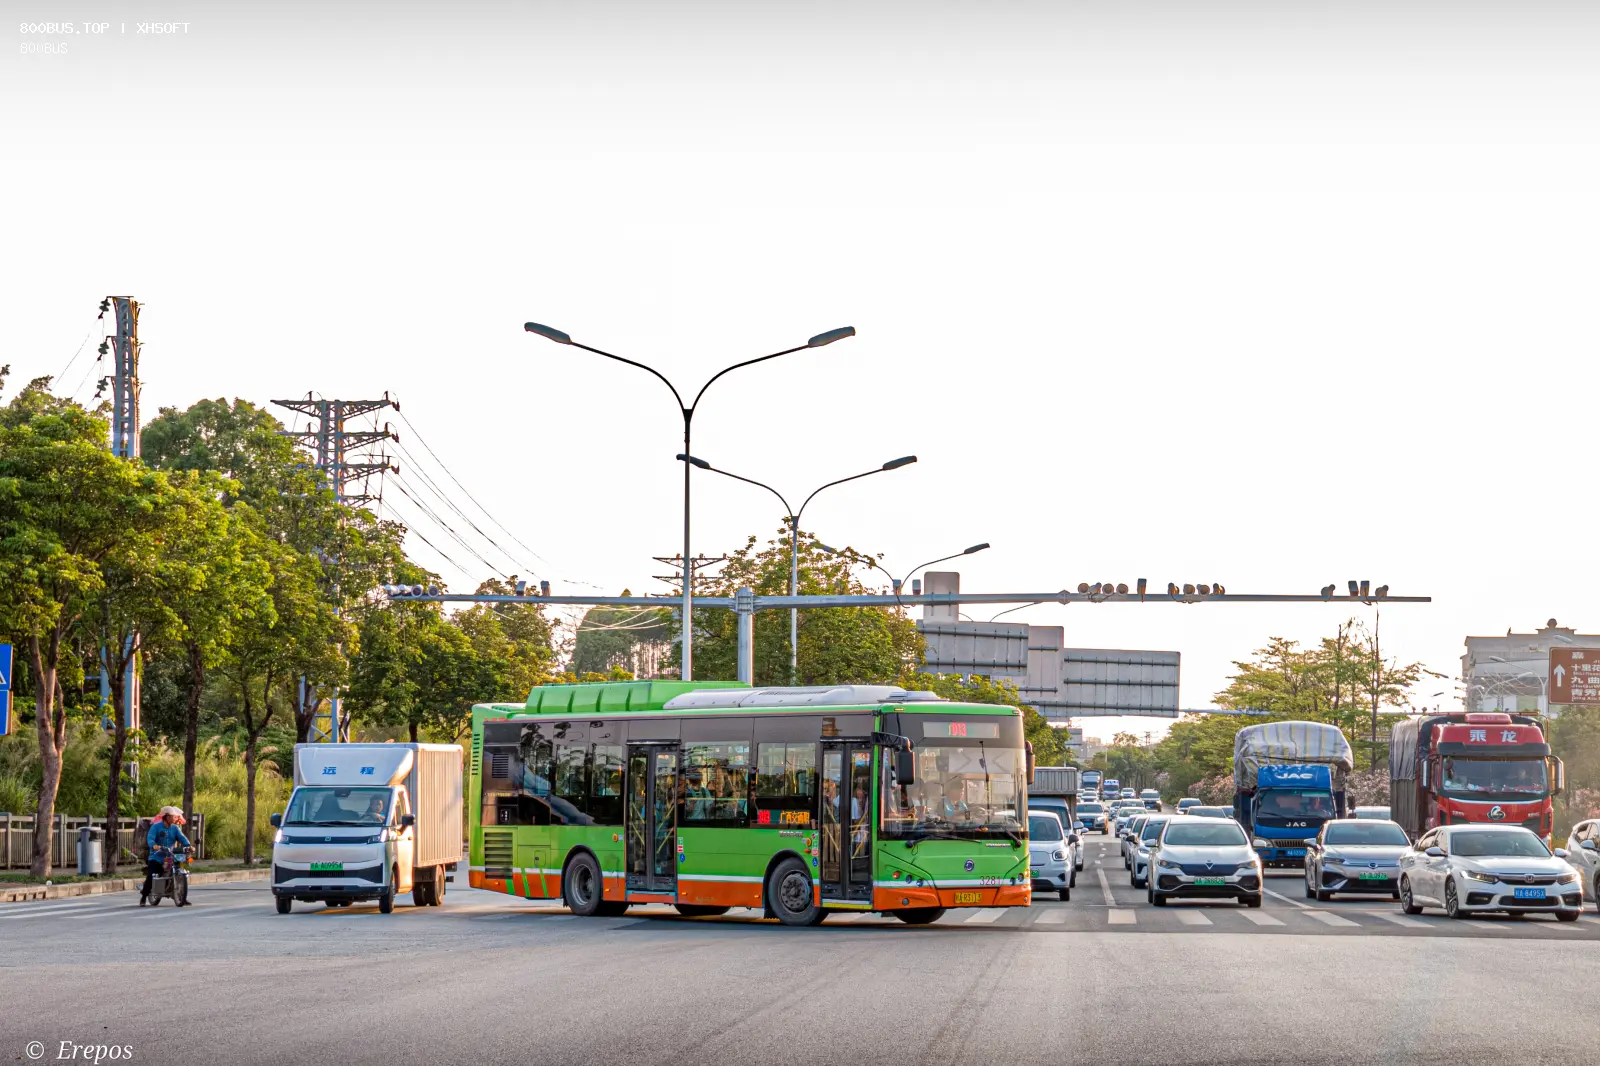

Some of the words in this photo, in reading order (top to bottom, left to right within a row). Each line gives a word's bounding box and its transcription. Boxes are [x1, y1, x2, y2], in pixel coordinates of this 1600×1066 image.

[1469, 729, 1518, 743] 乘龙
[322, 766, 375, 775] 远程
[979, 876, 1001, 886] 3281
